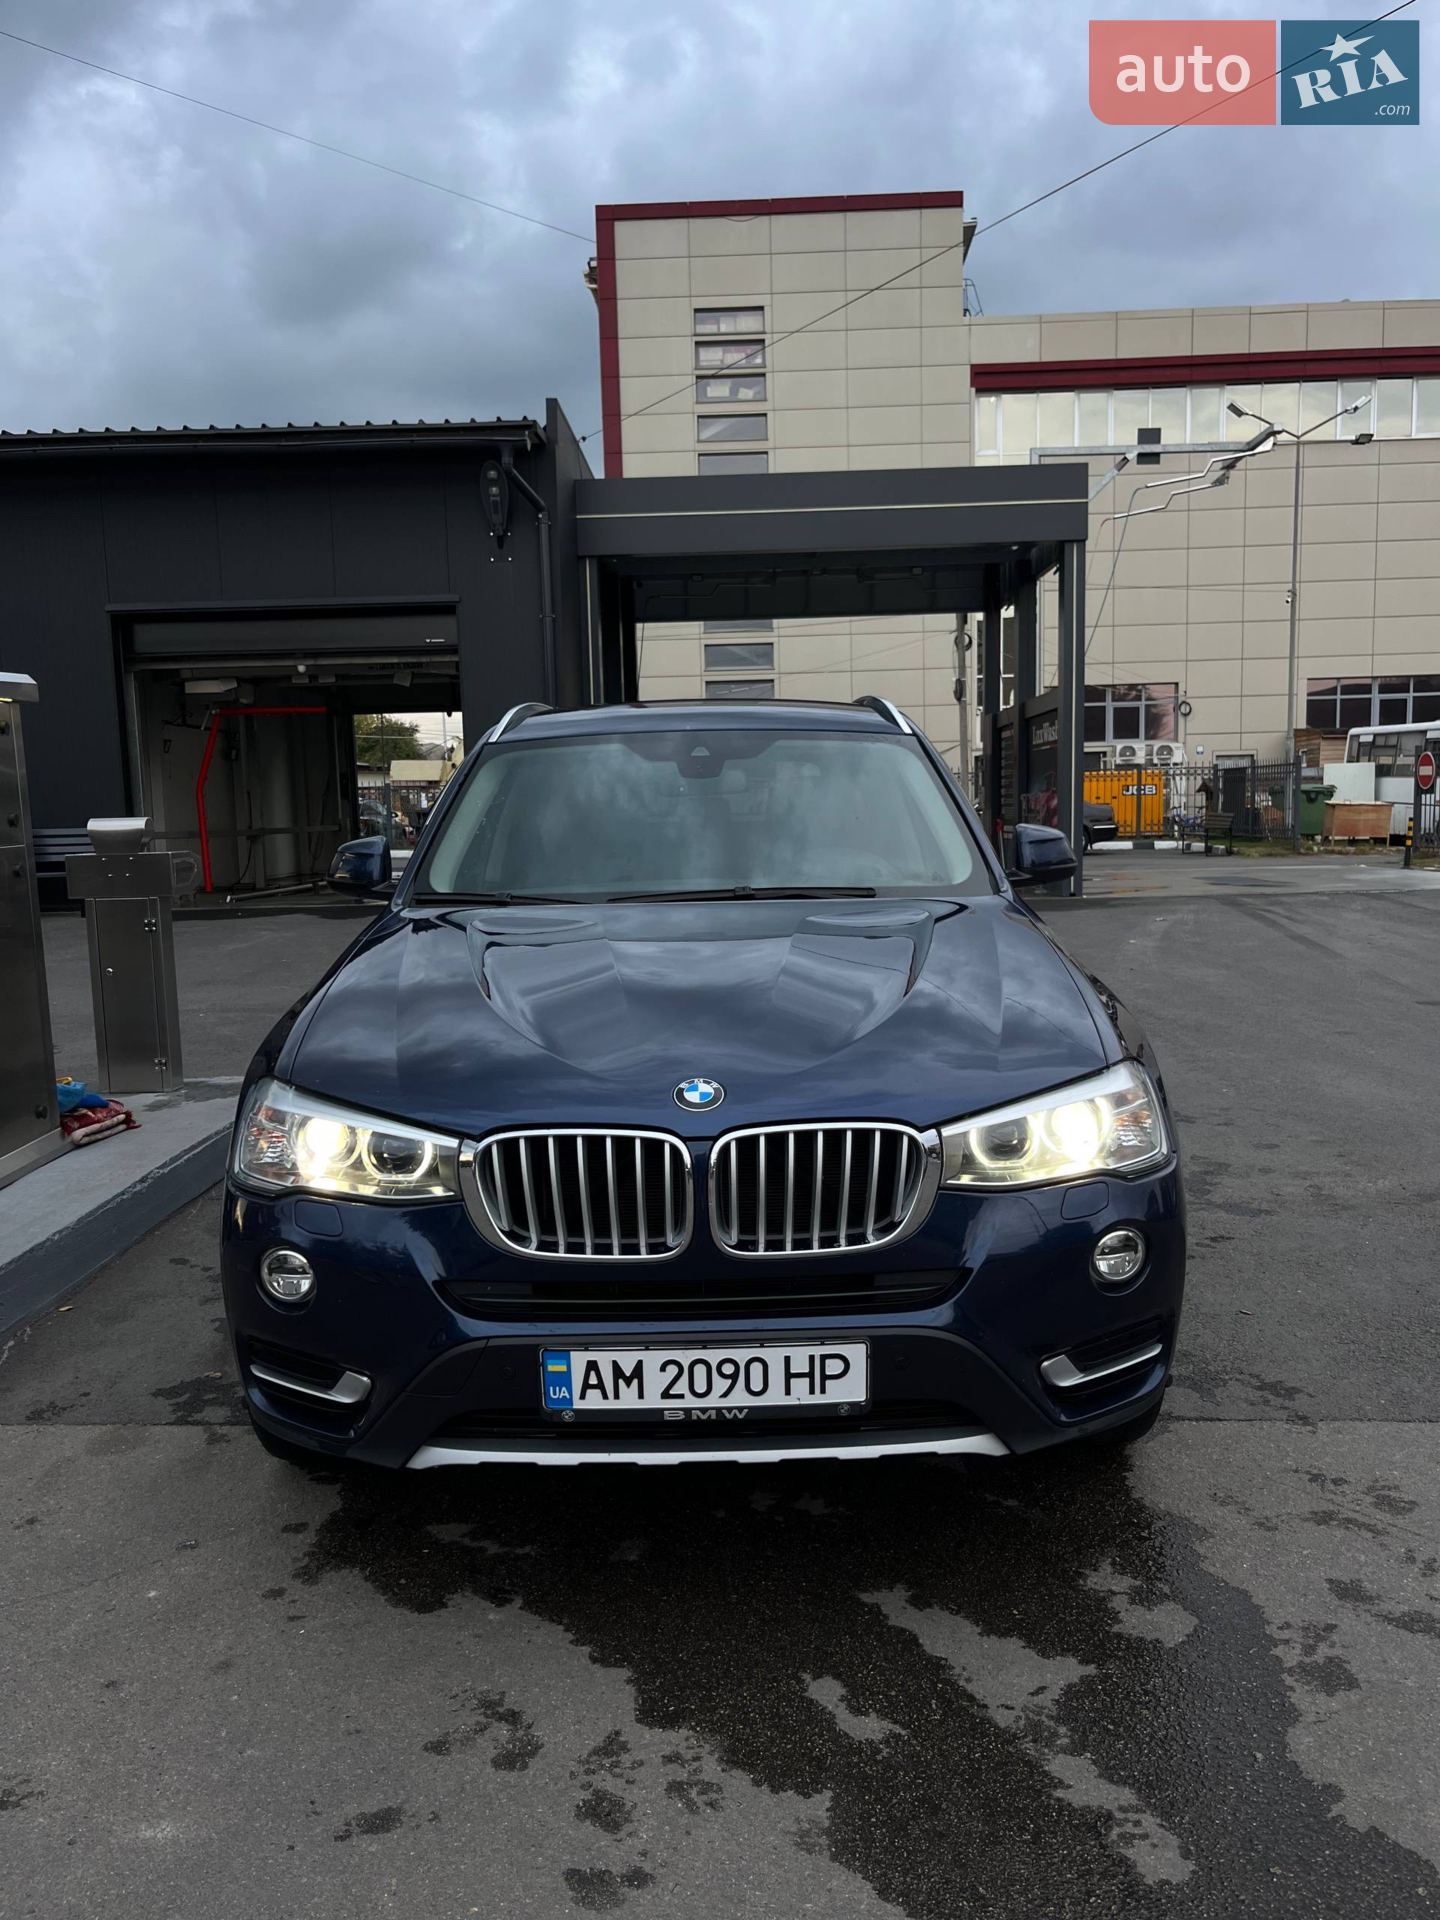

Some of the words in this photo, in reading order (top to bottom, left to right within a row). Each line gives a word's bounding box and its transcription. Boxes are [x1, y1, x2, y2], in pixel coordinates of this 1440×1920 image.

[1122, 785, 1157, 796] JCB
[579, 1359, 645, 1401] AM
[659, 1355, 770, 1400] 2090
[784, 1353, 851, 1397] HP
[549, 1386, 570, 1399] UA
[663, 1408, 750, 1421] BMW
